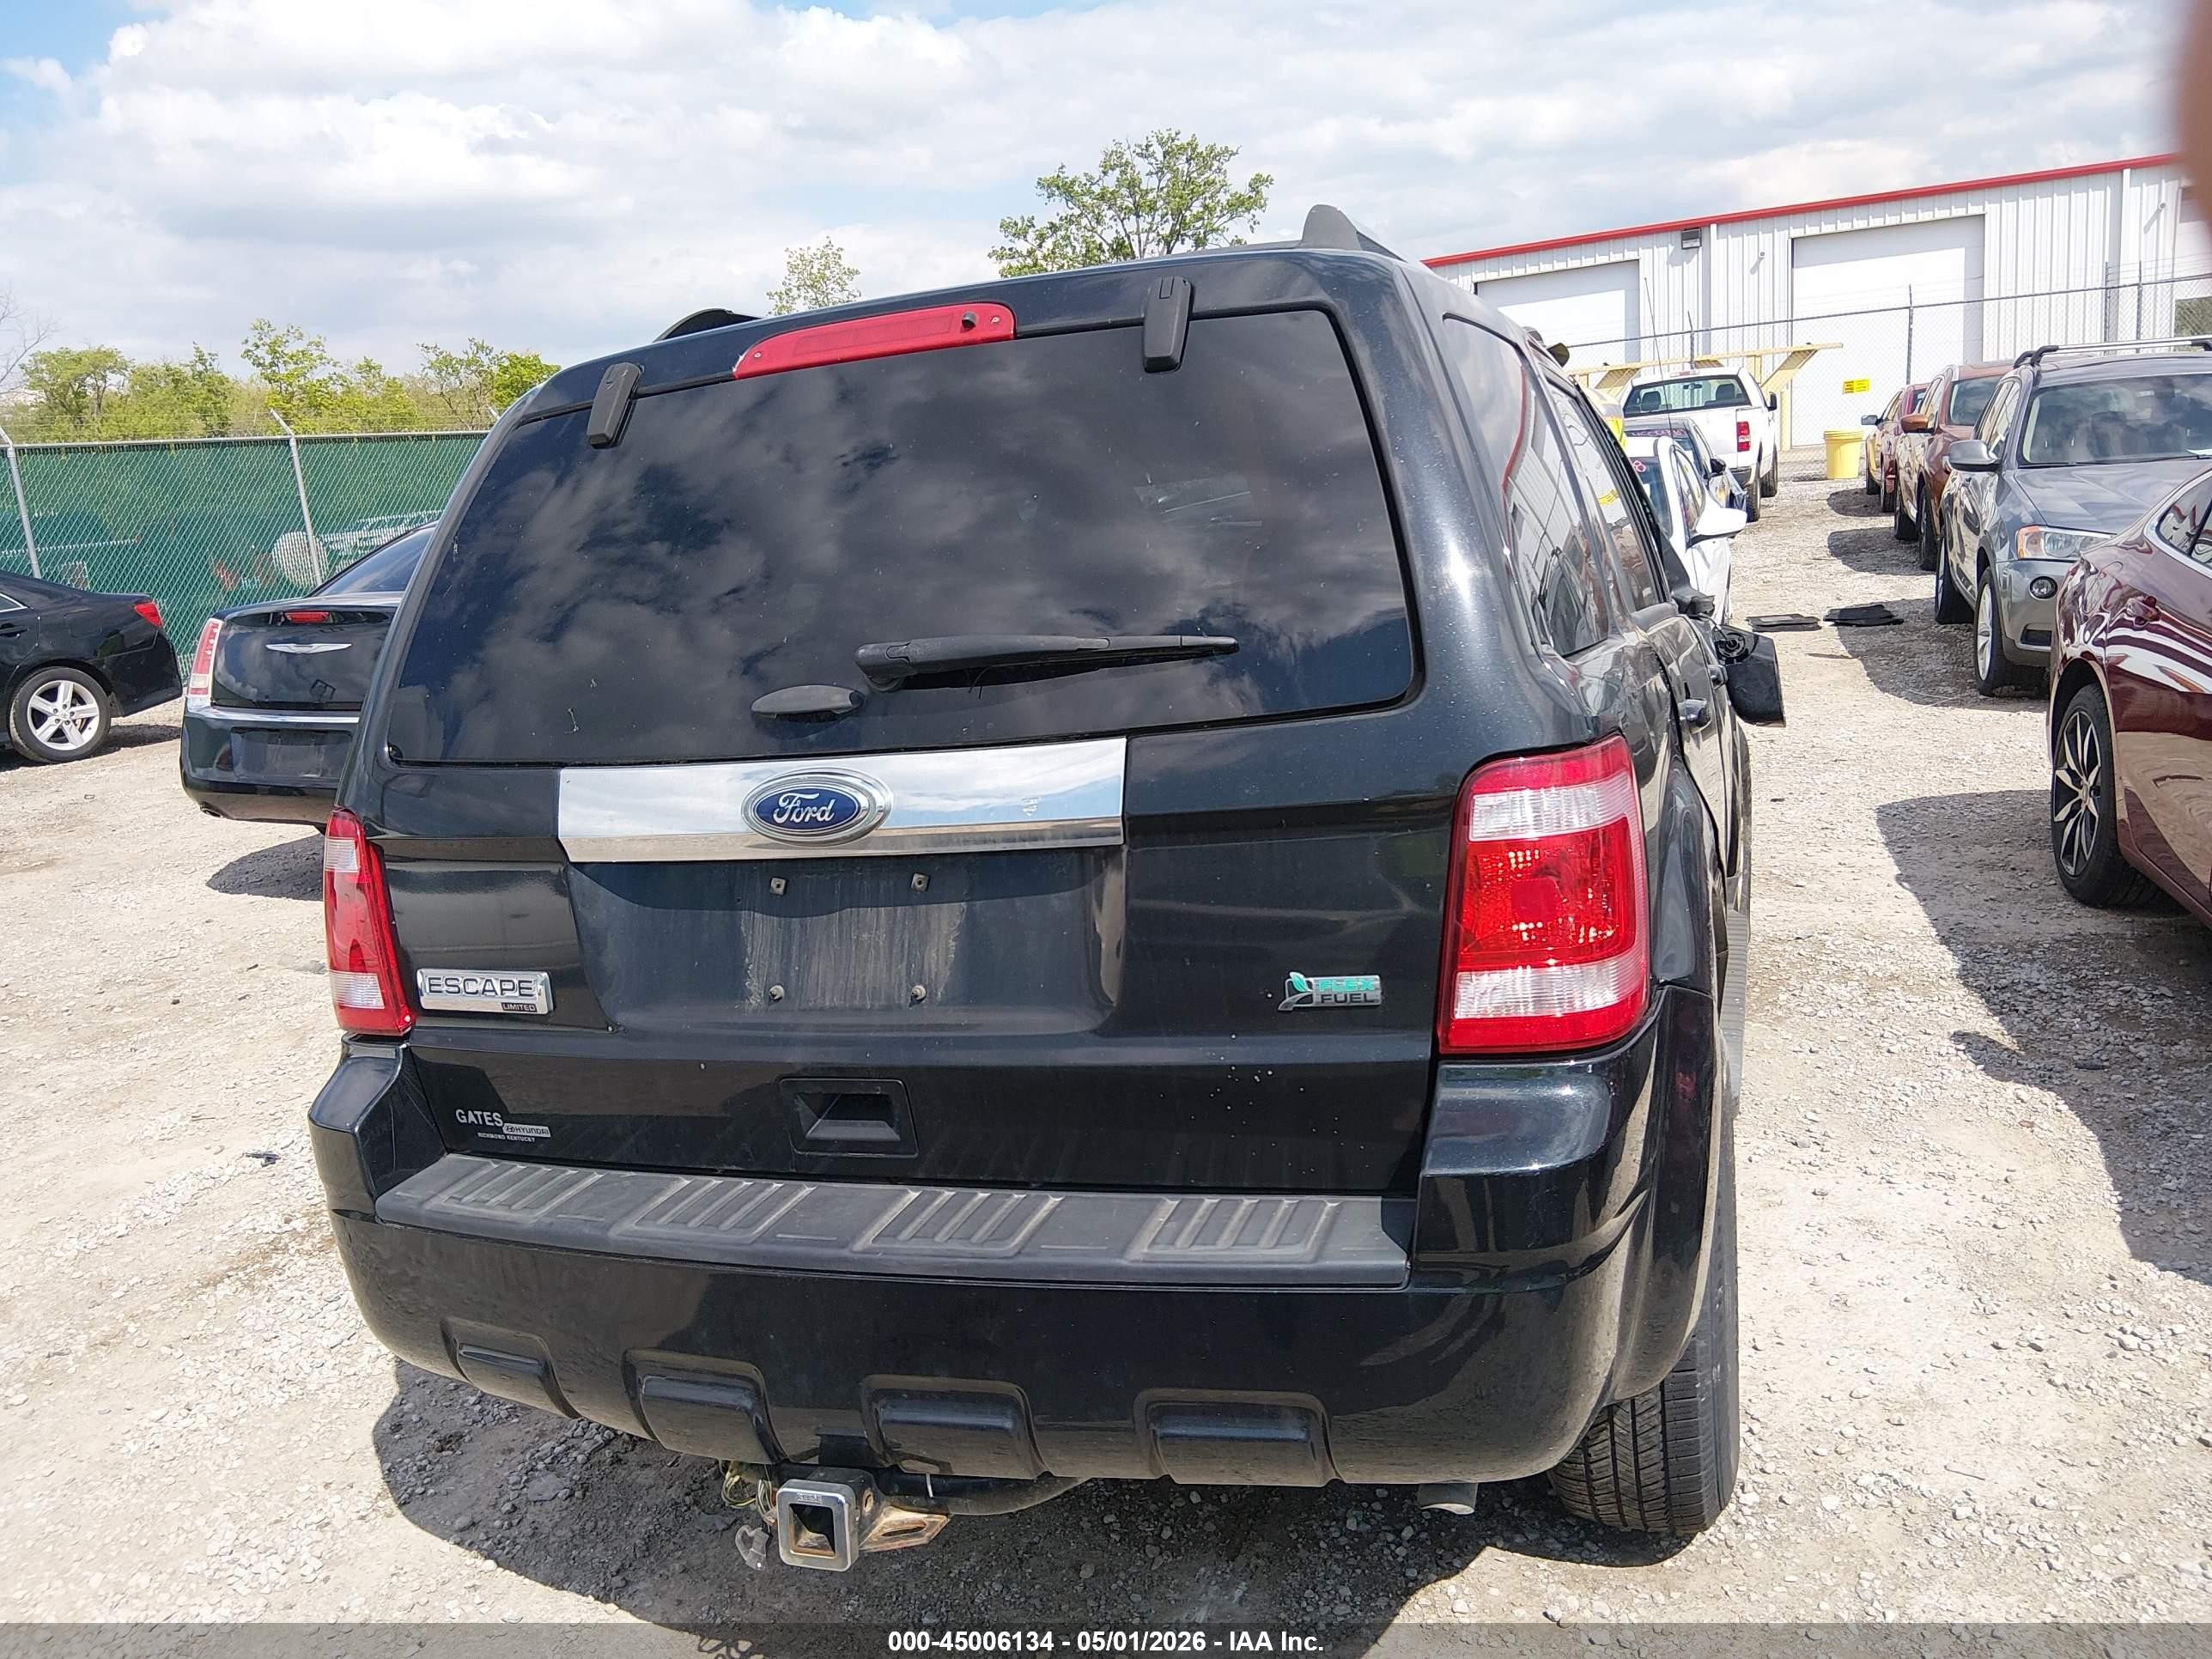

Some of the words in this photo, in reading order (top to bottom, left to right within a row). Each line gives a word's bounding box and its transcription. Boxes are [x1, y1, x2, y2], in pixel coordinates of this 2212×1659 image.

[773, 793, 836, 823] Ford
[428, 977, 534, 997] ESCAPE
[1318, 979, 1374, 991] FLEX
[1321, 994, 1375, 1003] FUEL
[503, 1003, 536, 1012] LIMITED
[455, 1109, 503, 1127] GATES
[514, 1127, 550, 1135] HYUNDAI
[506, 1134, 535, 1143] KENTUCKY
